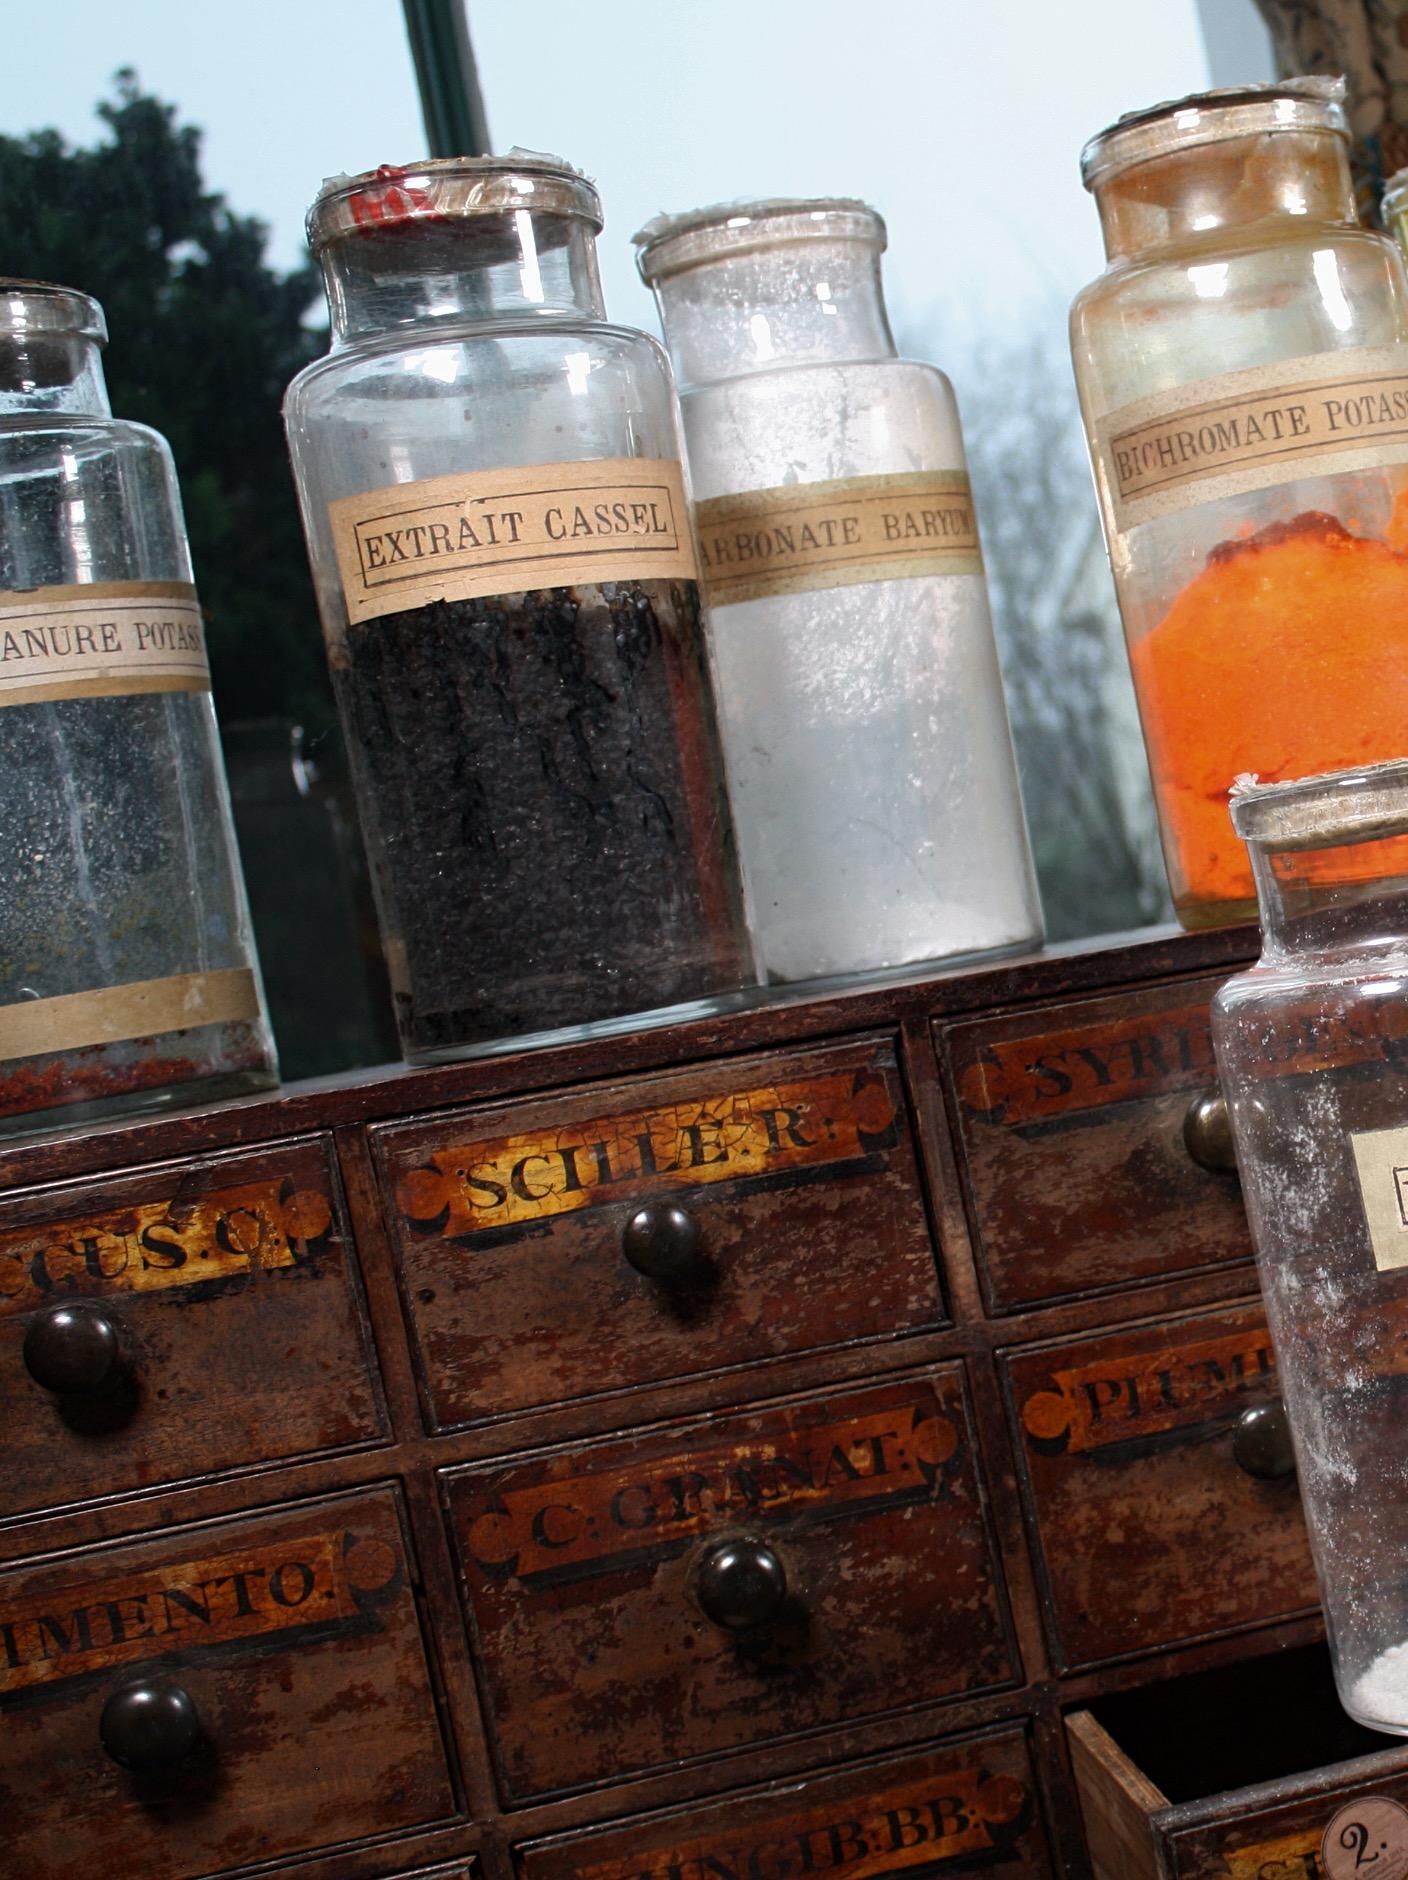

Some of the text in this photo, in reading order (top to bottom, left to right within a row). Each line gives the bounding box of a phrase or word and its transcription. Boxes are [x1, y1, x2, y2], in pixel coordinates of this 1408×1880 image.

[1116, 405, 1311, 482] BICHROMATE
[364, 502, 668, 569] EXTRAIT CASSEL
